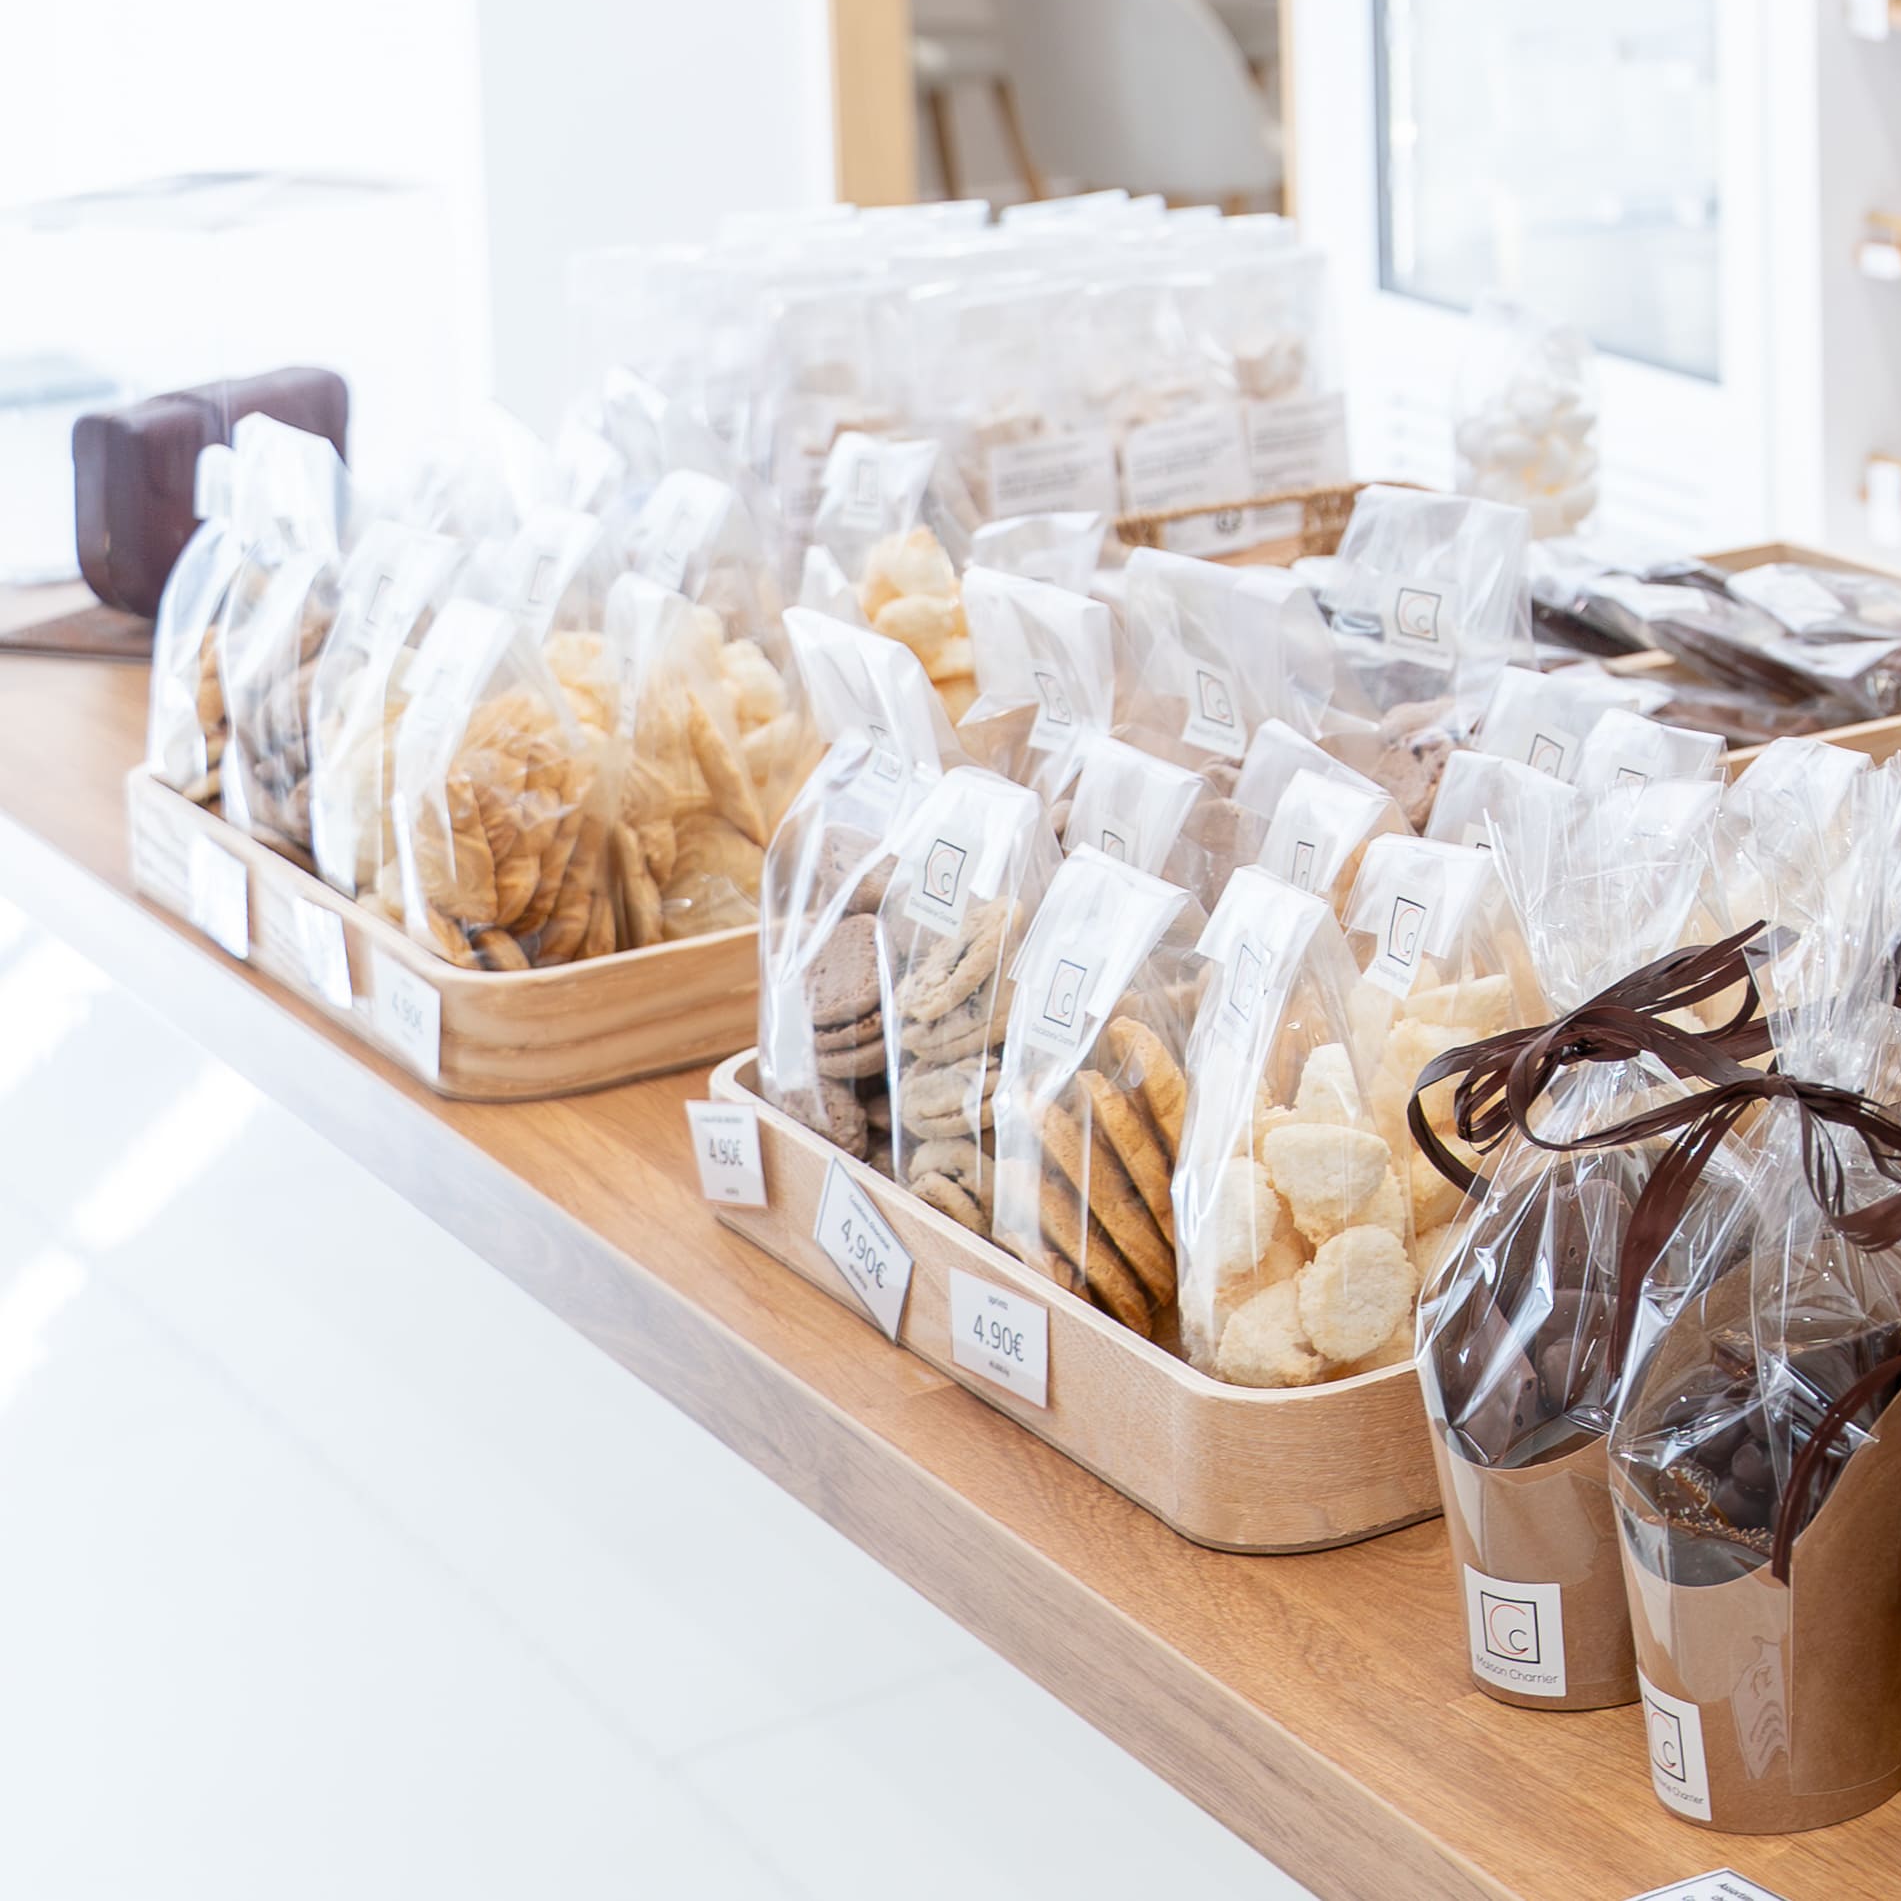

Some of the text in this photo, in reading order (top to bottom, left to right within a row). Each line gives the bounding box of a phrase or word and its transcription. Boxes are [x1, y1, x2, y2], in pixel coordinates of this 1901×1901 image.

[841, 1218, 888, 1289] 4,90€
[973, 1313, 1025, 1363] 4.90€
[1508, 1667, 1560, 1685] Charrier
